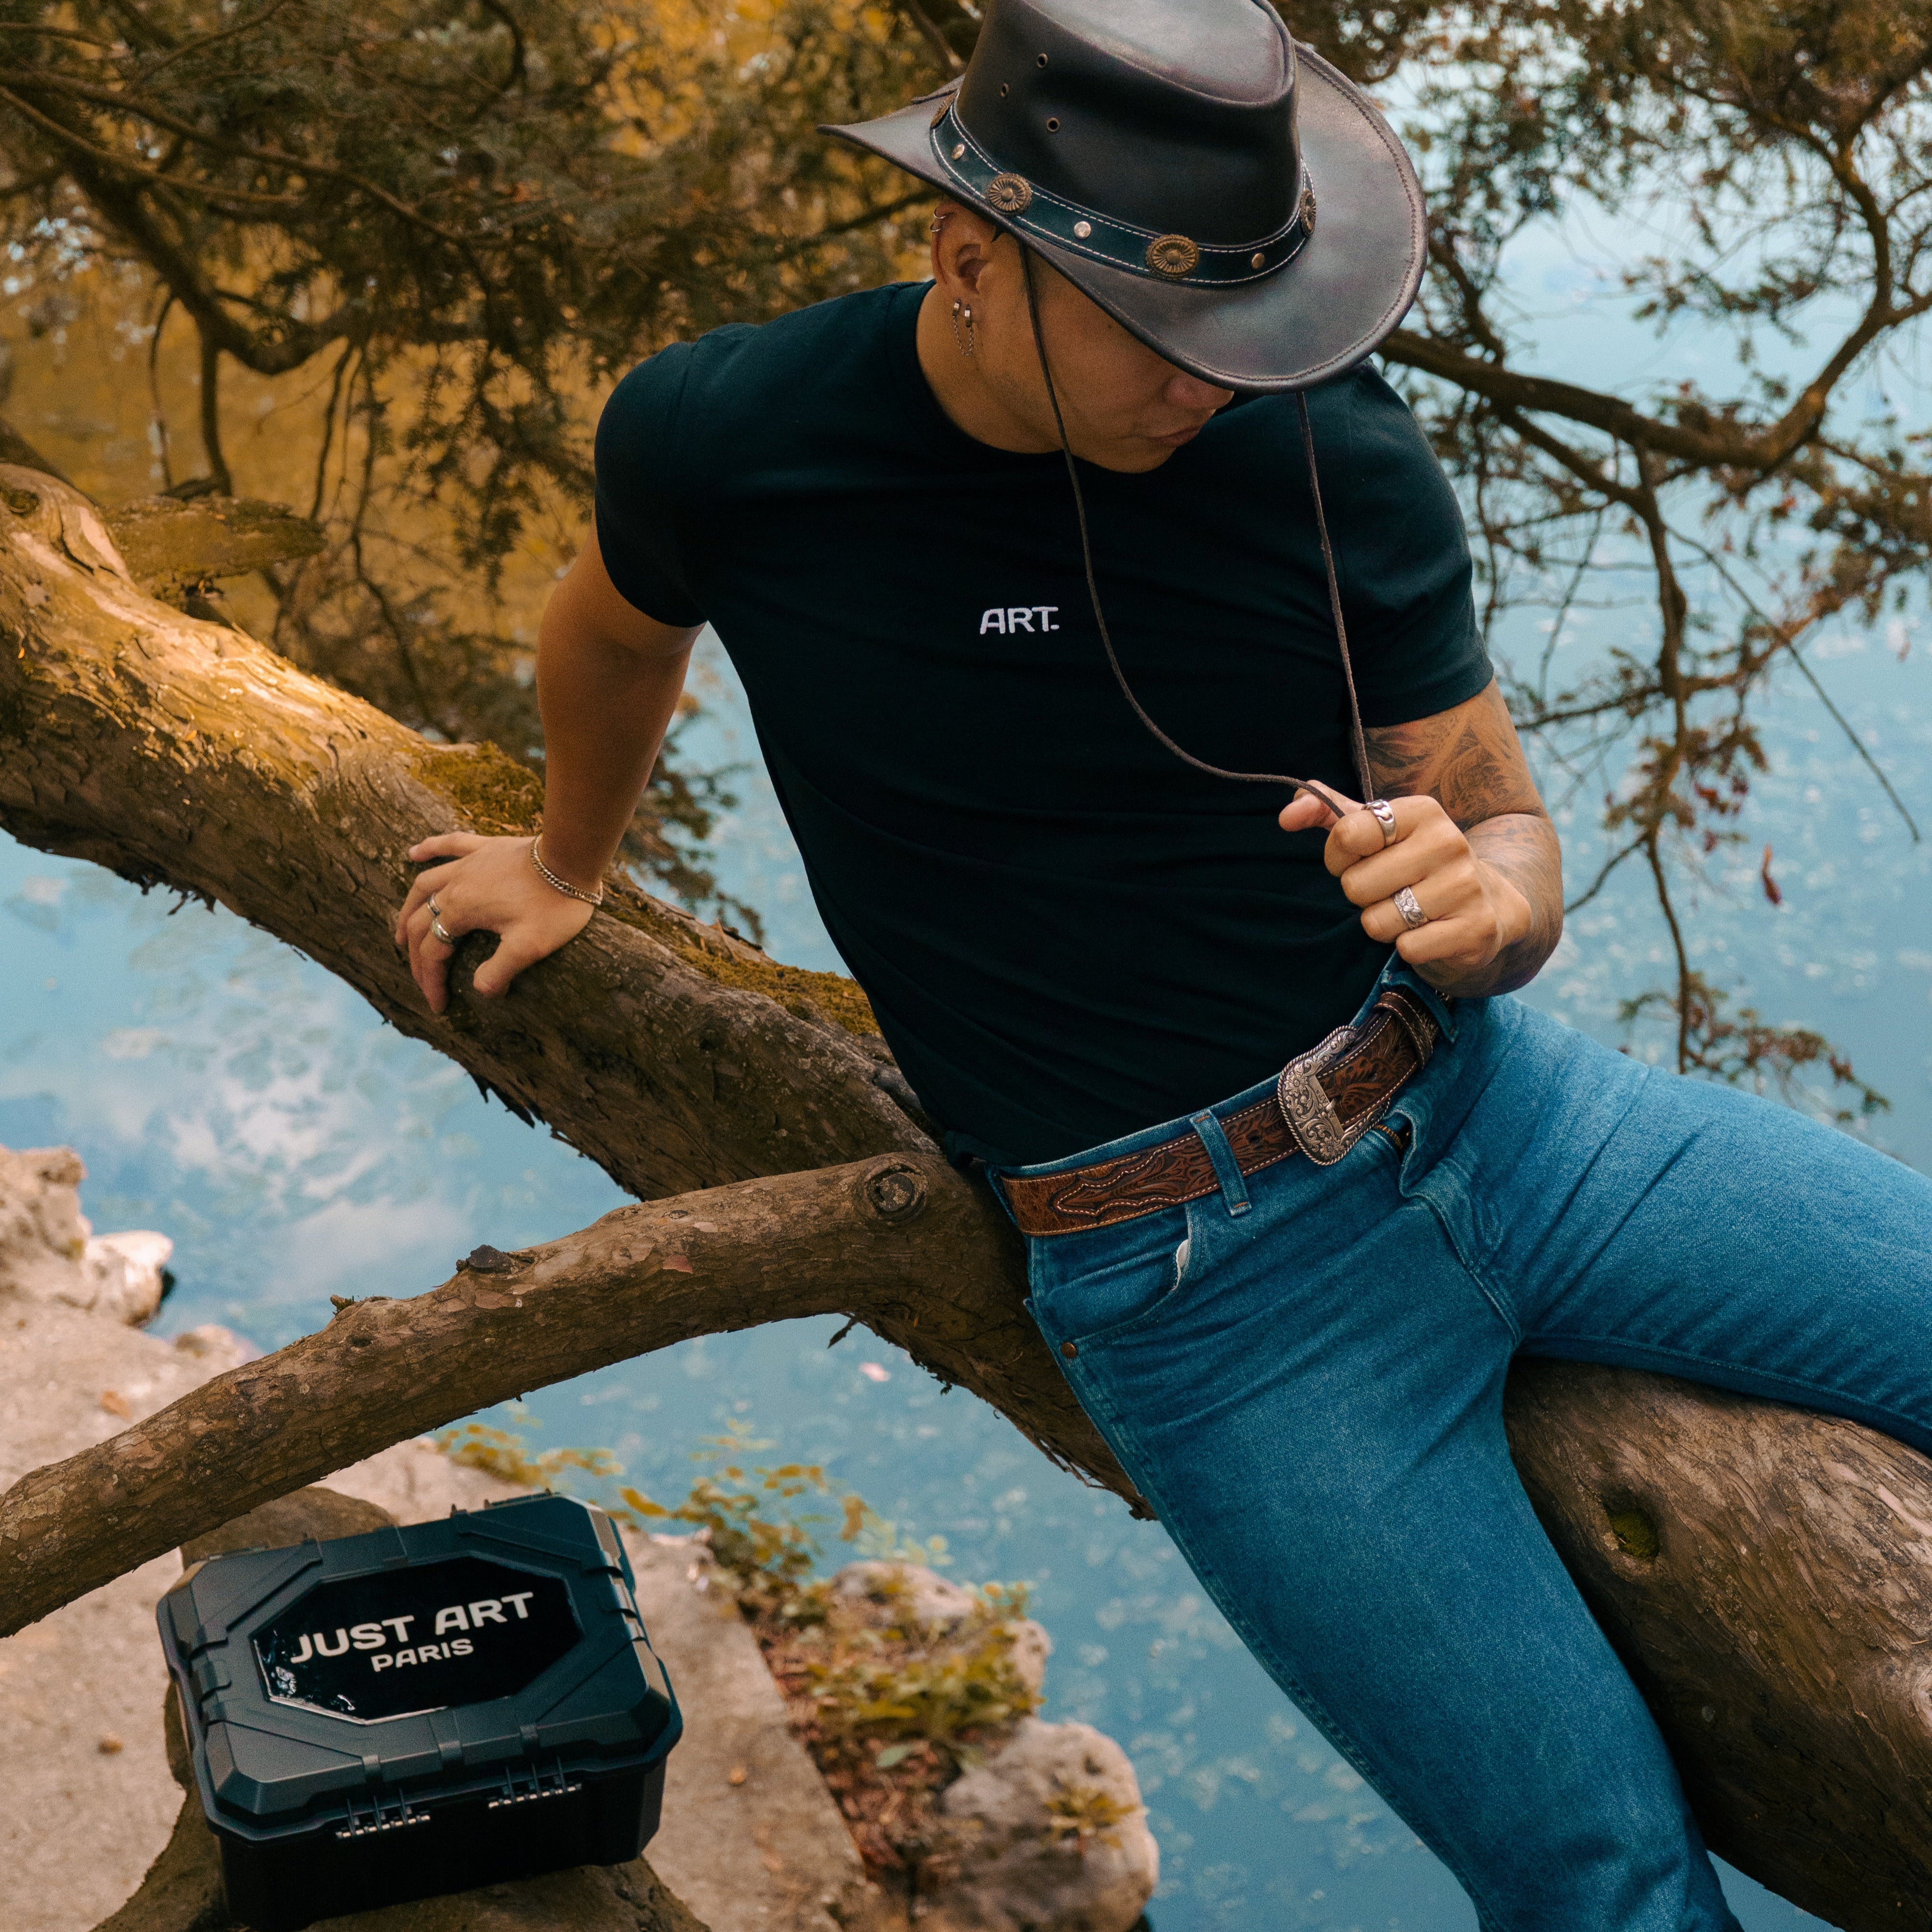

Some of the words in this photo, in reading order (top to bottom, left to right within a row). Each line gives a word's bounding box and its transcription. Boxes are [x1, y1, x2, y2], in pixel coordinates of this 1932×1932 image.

[980, 606, 1059, 634] ART.
[290, 1615, 414, 1663] JUST
[436, 1592, 533, 1635] ART
[371, 1638, 474, 1672] PARIS
